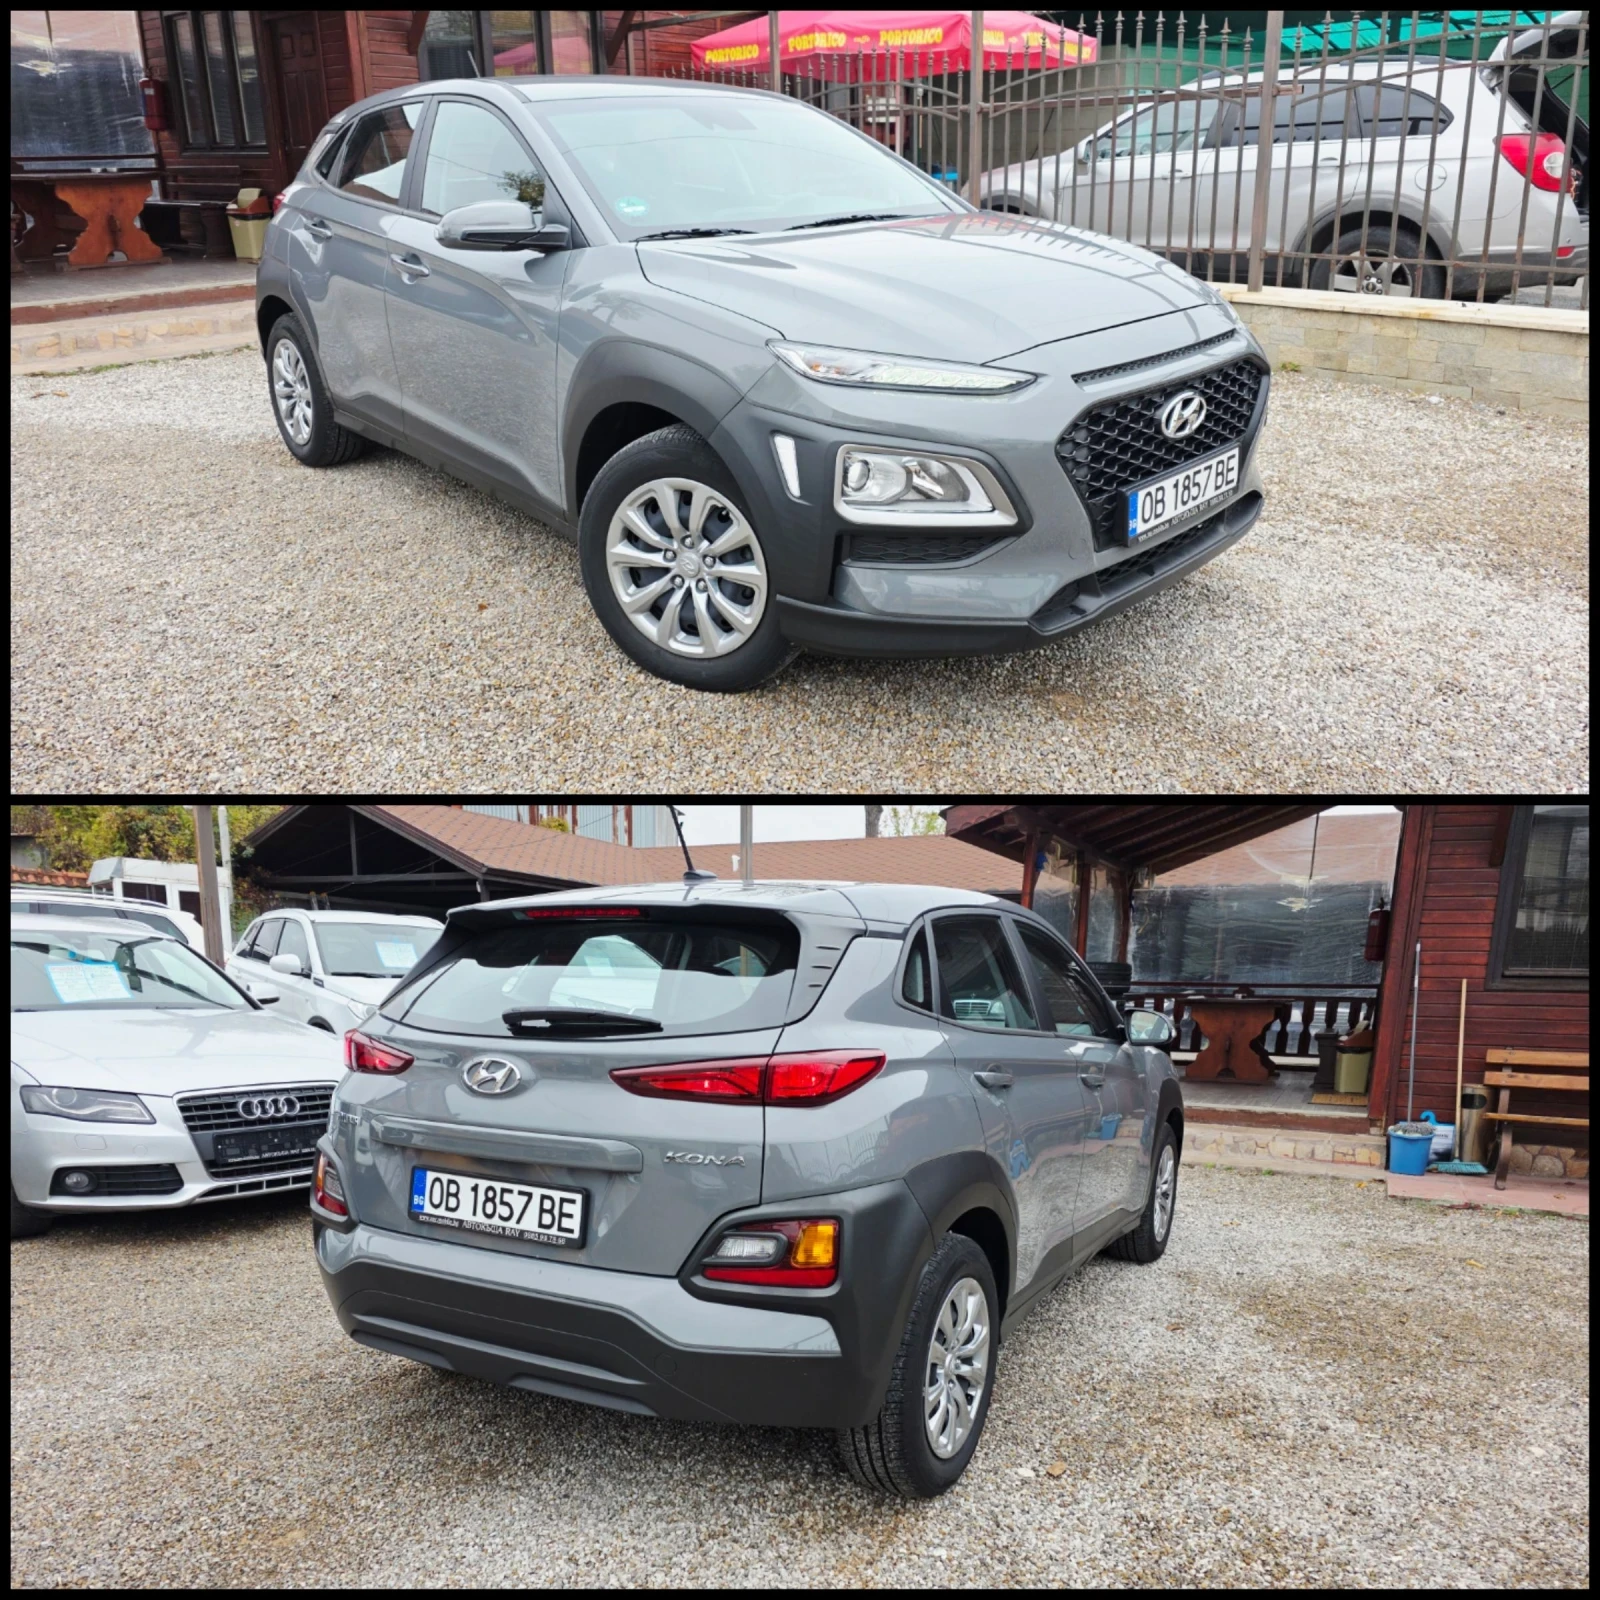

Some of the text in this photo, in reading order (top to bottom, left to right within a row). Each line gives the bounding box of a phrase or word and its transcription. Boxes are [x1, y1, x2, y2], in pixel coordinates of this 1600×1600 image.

[788, 32, 846, 52] PORTORICO
[705, 44, 759, 63] PORTORICO
[1141, 485, 1166, 524] OB
[1173, 464, 1213, 511] 1857
[1214, 454, 1236, 491] BE
[663, 1151, 746, 1167] KONA
[413, 1194, 425, 1205] BG
[429, 1176, 577, 1234] OB 1857 BE
[505, 1227, 520, 1238] RAY
